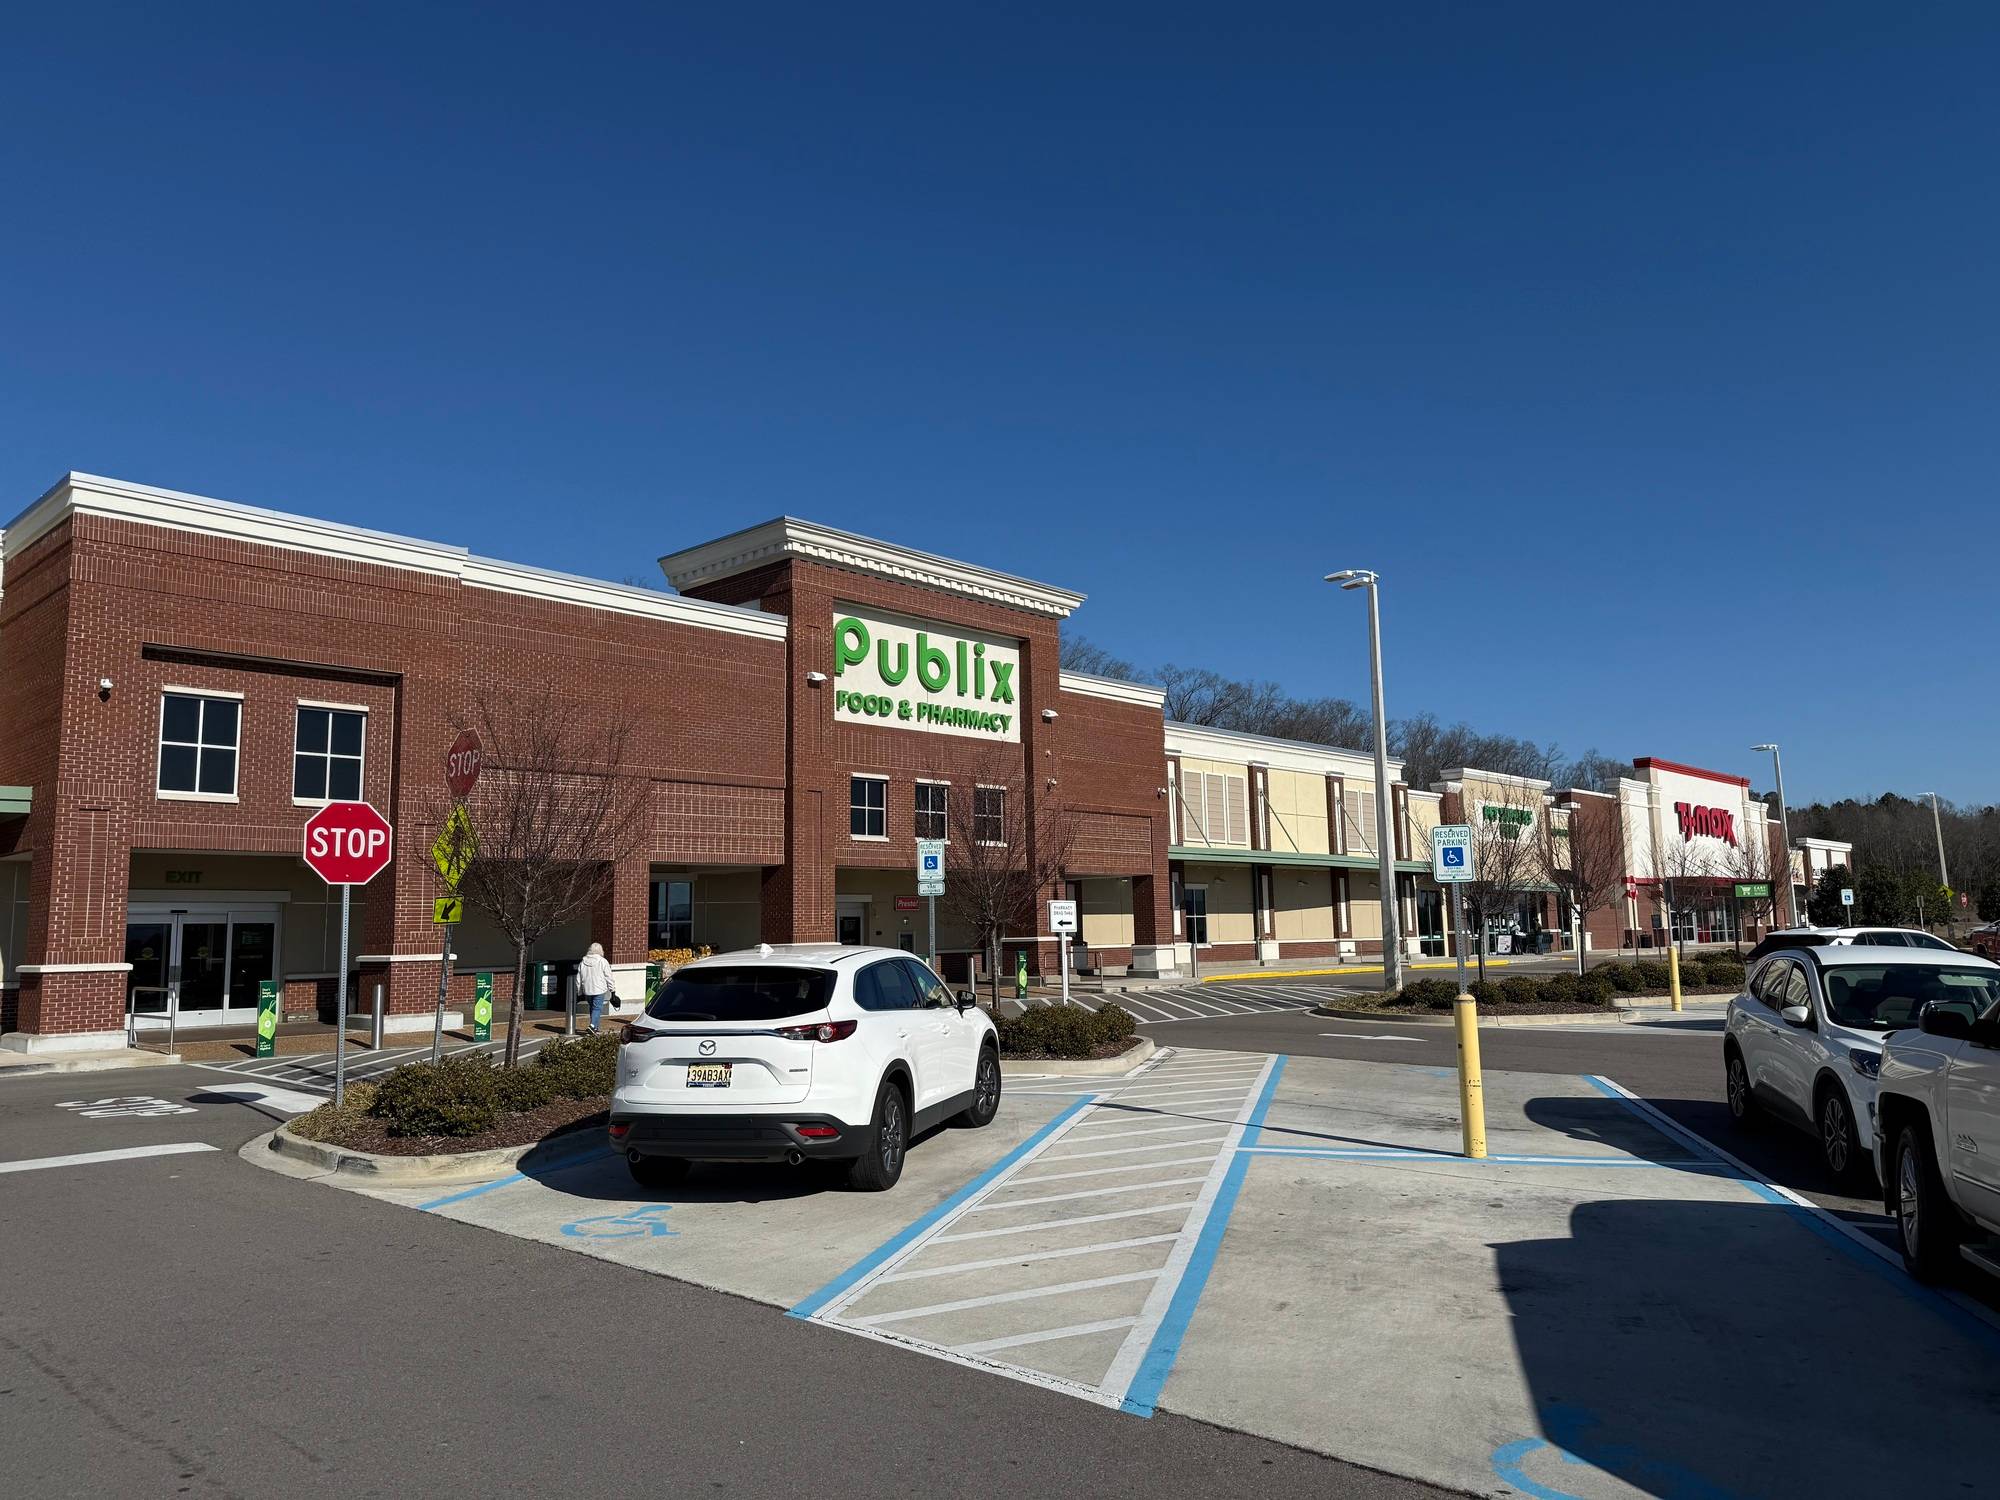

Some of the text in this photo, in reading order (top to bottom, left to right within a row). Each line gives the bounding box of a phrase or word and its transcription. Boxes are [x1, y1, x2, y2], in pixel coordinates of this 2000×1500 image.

[834, 617, 1015, 704] Publix
[836, 690, 1012, 733] FOOD & PHARMACY
[449, 750, 480, 778] STOP
[310, 827, 386, 858] STOP
[1435, 830, 1468, 838] RESERVED
[1437, 838, 1467, 846] PARKING
[165, 870, 203, 884] EXIT
[691, 1069, 729, 1082] 39AB3AX
